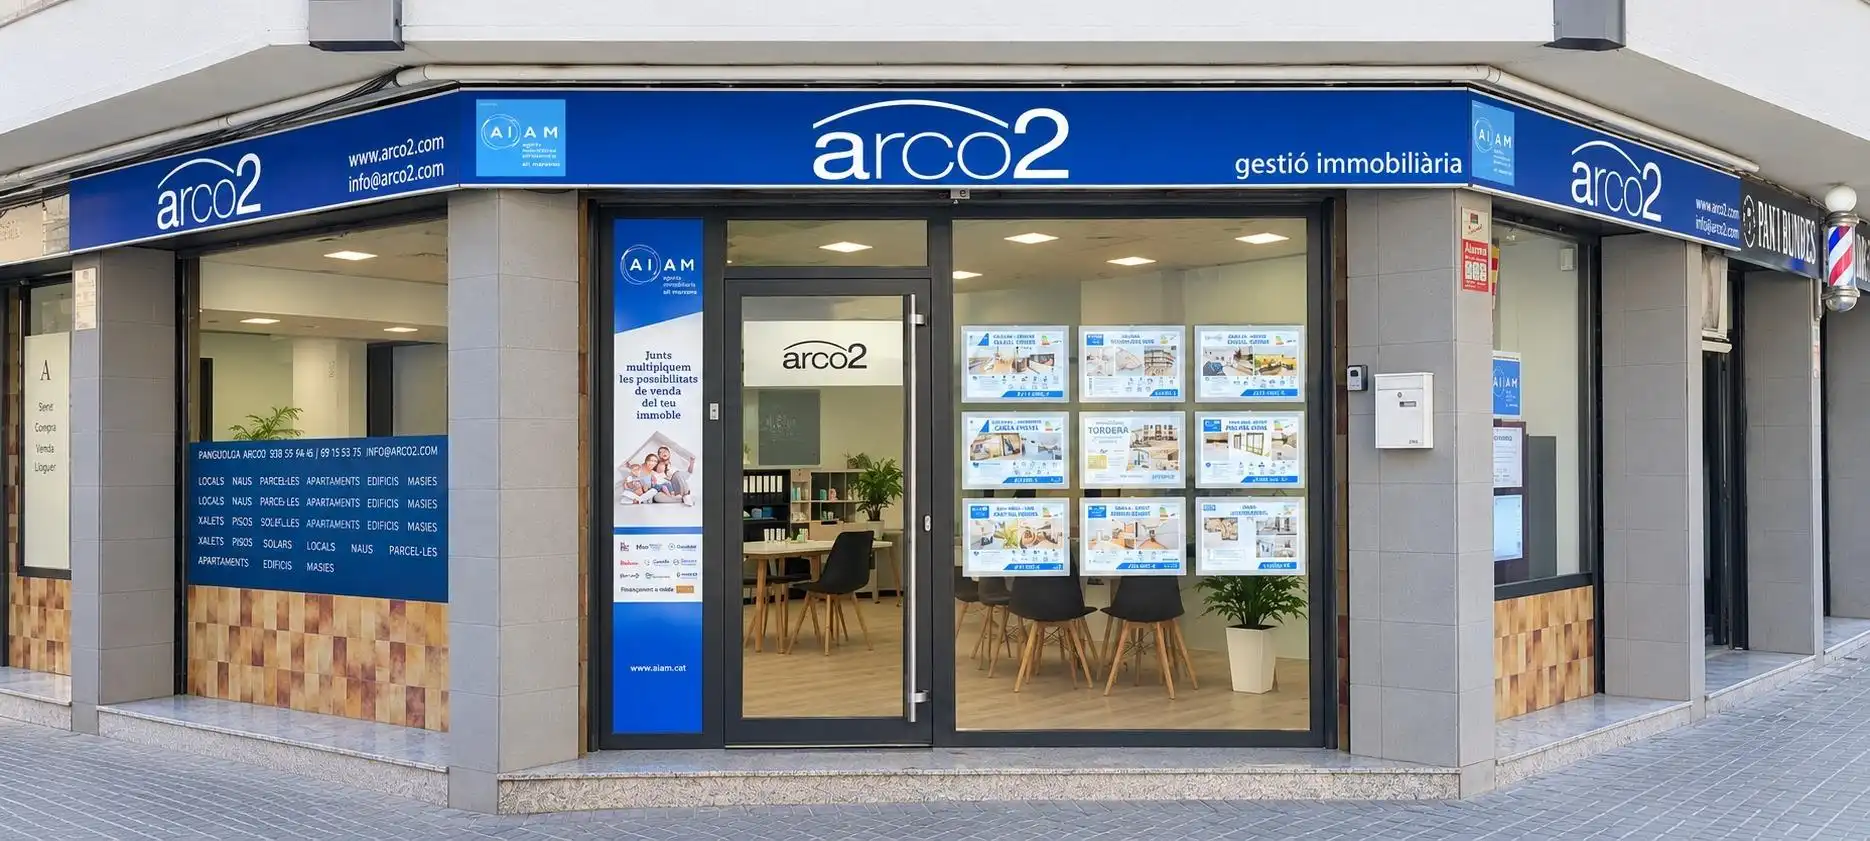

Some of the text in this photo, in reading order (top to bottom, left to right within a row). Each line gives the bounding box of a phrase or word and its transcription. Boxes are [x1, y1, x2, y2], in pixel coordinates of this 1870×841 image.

[348, 137, 445, 168] www.arco2.com
[812, 108, 1070, 180] arco2
[1235, 150, 1311, 182] gestió
[1316, 150, 1463, 176] immobiliària
[348, 161, 445, 194] info@arco2.com
[157, 152, 261, 230] arco2
[1571, 160, 1662, 223] arco2
[1695, 197, 1740, 220] www.arco2.com
[645, 350, 672, 361] Junts
[783, 343, 867, 370] arco2
[40, 359, 51, 381] A
[619, 374, 634, 384] les
[634, 386, 681, 396] de venda
[641, 398, 677, 408] del teu
[636, 410, 682, 420] immoble
[1088, 426, 1129, 435] TORDERA
[35, 443, 55, 454] Venda
[366, 445, 438, 458] INFO@ARCO2.COM
[198, 476, 225, 486] LOCALS
[232, 476, 253, 486] NAUS
[306, 476, 361, 486] APARTAMENTS
[367, 476, 399, 486] EDIFICIS
[407, 476, 438, 486] MASIES
[198, 496, 225, 506] LOCALS
[232, 496, 253, 506] NAUS
[306, 497, 361, 507] APARTAMENTS
[367, 498, 399, 508] EDIFICIS
[407, 499, 438, 509] MASIES
[198, 516, 225, 526] XALETS
[232, 516, 253, 527] PISOS
[306, 519, 361, 530] APARTAMENTS
[367, 520, 399, 531] EDIFICIS
[407, 522, 438, 533] MASIES
[198, 536, 225, 546] XALETS
[232, 537, 253, 547] PISOS
[263, 539, 293, 549] SOLARS
[306, 541, 336, 552] LOCALS
[351, 543, 374, 554] NAUS
[198, 556, 335, 573] APARTAMENTS EDIFICIS MASIES
[630, 663, 687, 674] www.aiam.cat
